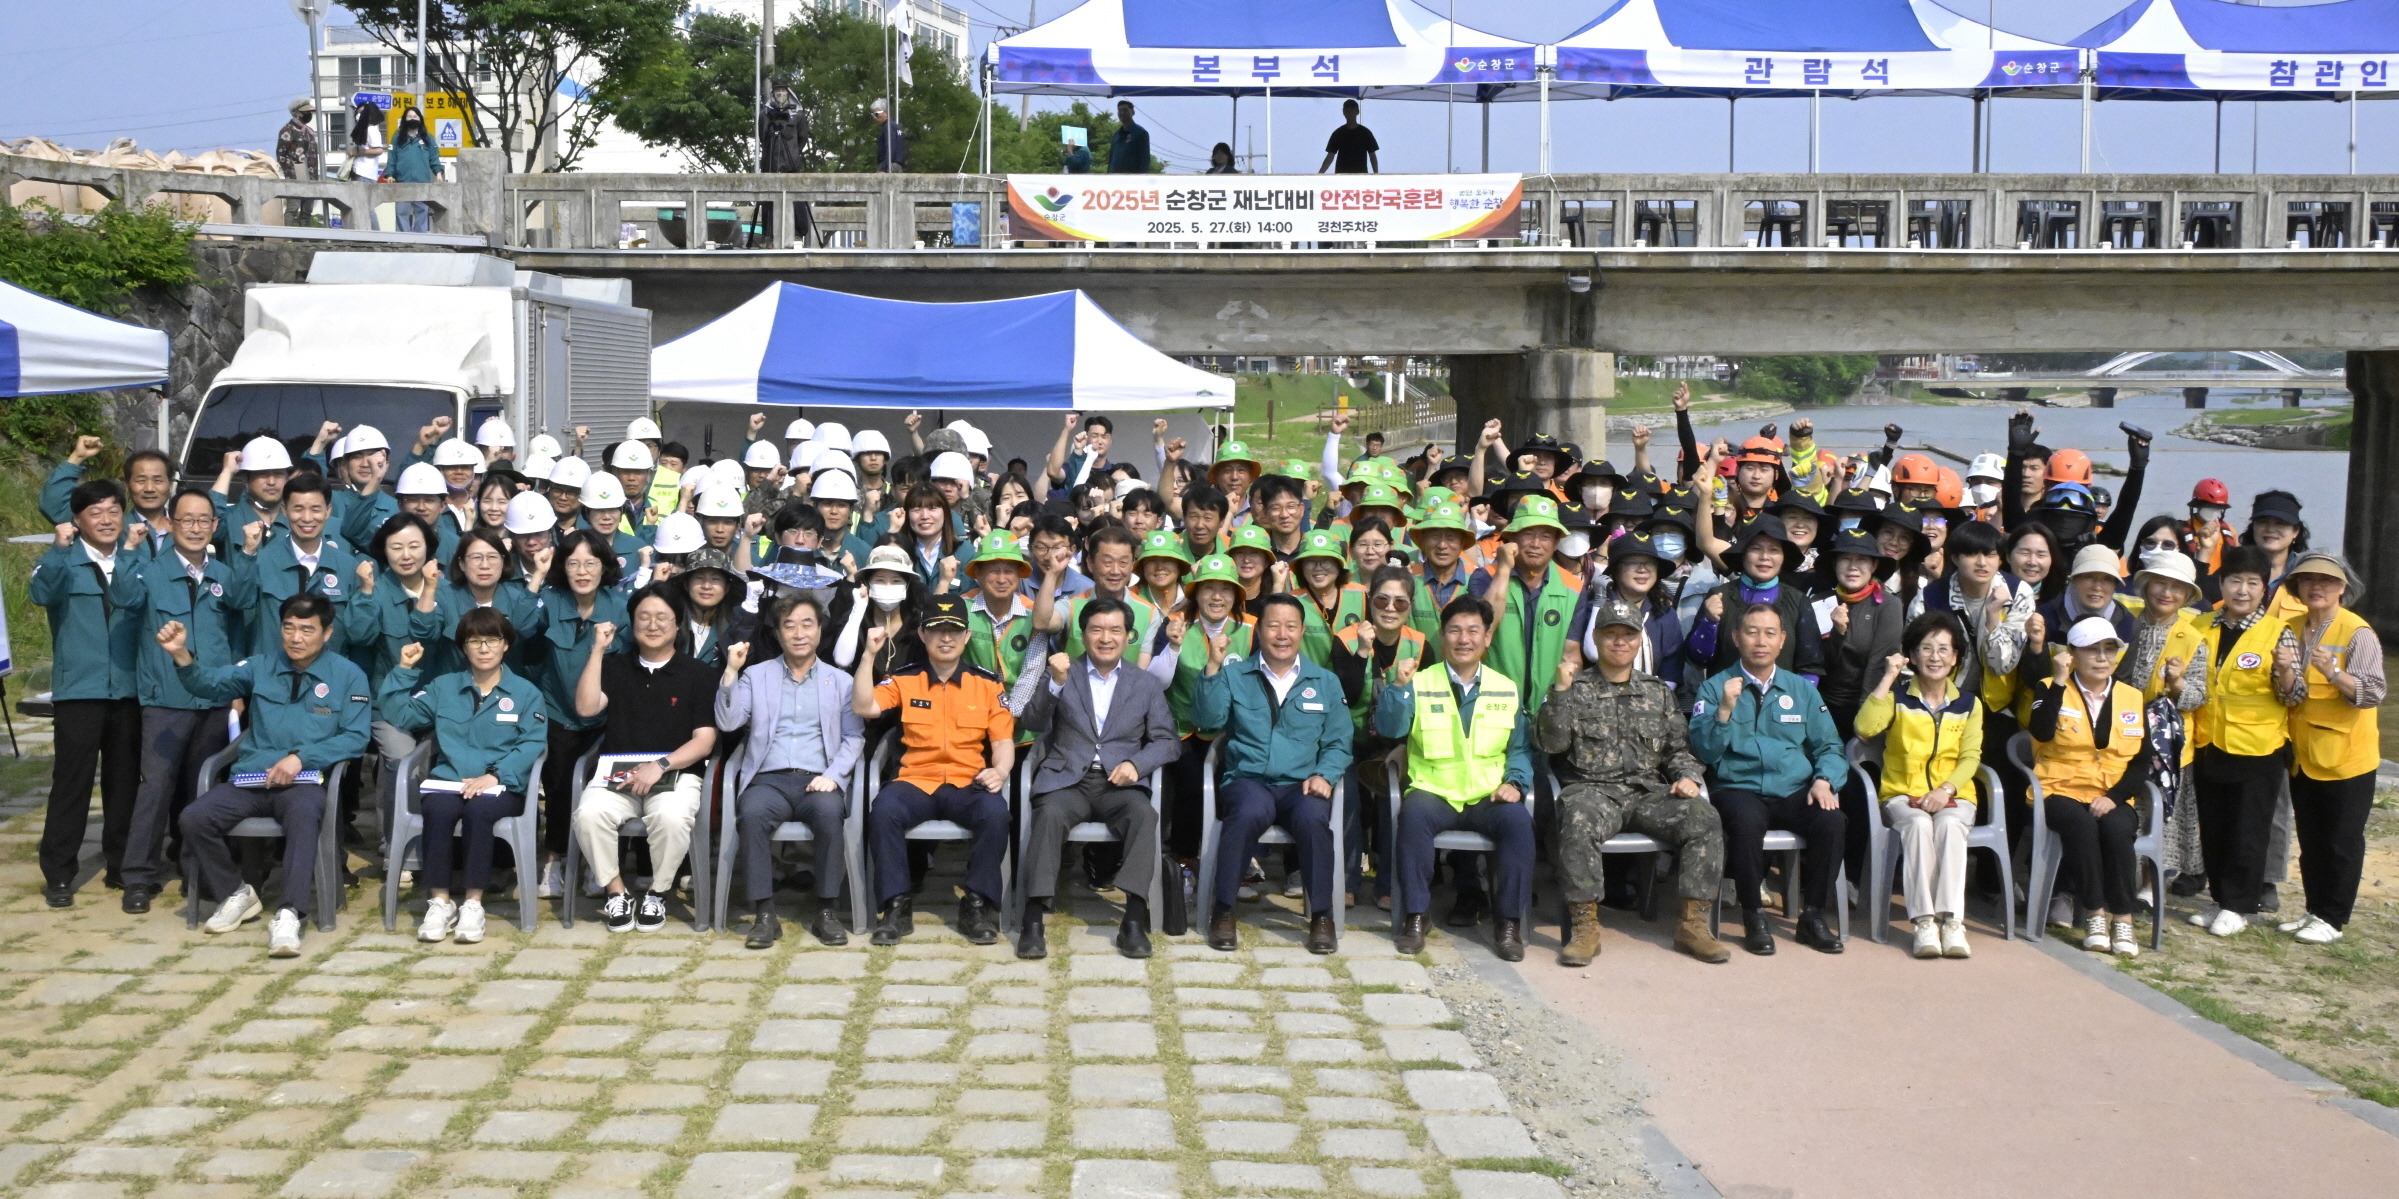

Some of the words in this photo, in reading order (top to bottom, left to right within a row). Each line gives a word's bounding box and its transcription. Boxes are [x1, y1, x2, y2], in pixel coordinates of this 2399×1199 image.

[1192, 55, 1339, 83] 본부석
[1477, 58, 1515, 71] 순창군
[1744, 57, 1889, 85] 관람석
[2023, 62, 2060, 74] 순창군
[2270, 60, 2388, 86] 참관인
[1082, 190, 1159, 211] 2025년
[1166, 190, 1227, 211] 순창군
[1233, 190, 1314, 211] 재난대비
[1320, 189, 1443, 210] 안전한국훈련
[1449, 198, 1480, 210] 행복한
[1483, 197, 1504, 210] 순창
[1043, 213, 1066, 222] 순창군
[1147, 222, 1185, 234] 2025.
[1191, 222, 1203, 234] 5.
[1209, 221, 1251, 234] 27.(화)
[1257, 221, 1293, 234] 14:00
[1317, 221, 1378, 234] 경천주차장
